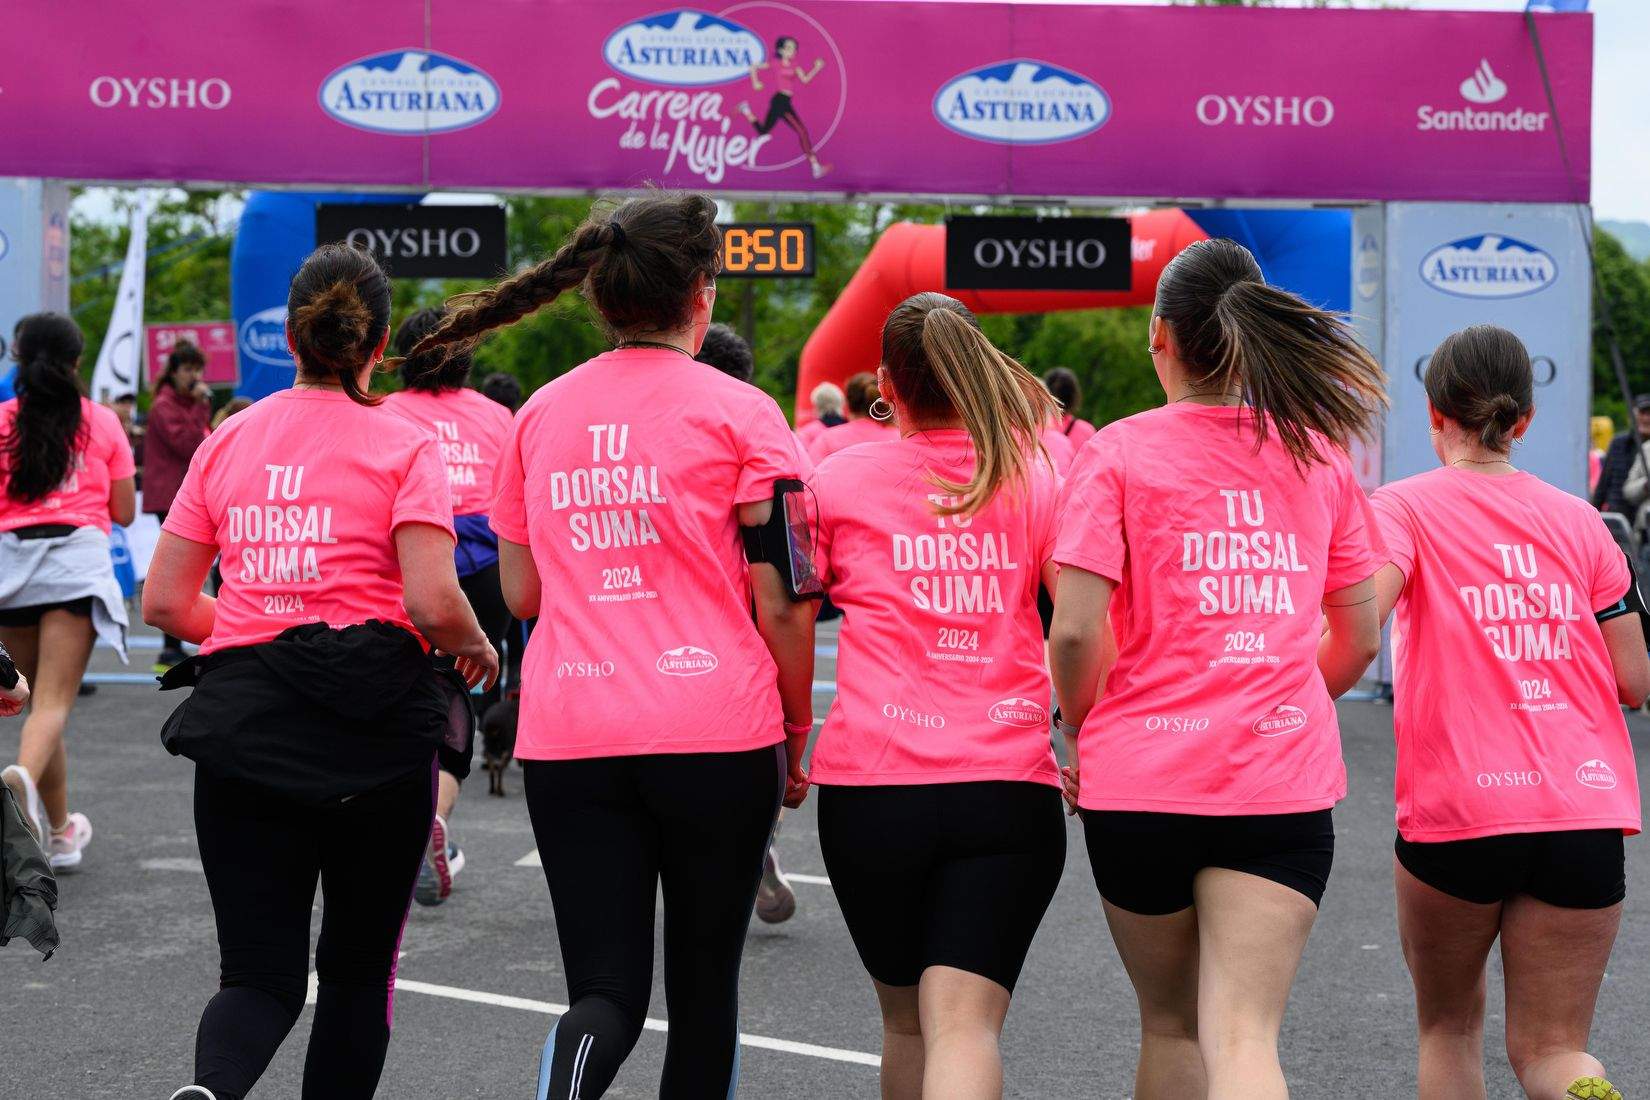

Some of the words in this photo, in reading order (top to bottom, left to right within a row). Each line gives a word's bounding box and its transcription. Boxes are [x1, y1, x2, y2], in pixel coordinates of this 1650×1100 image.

[617, 37, 750, 66] ASTURIANA
[89, 76, 231, 109] OYSHO
[335, 80, 484, 111] ASTURIANA
[588, 78, 724, 119] Carrera
[949, 90, 1095, 121] ASTURIANA
[1196, 94, 1334, 126] OYSHO
[1417, 105, 1549, 131] Santander
[619, 122, 646, 148] de
[650, 120, 670, 150] la
[663, 117, 772, 183] Mujer
[346, 227, 481, 258] OYSHO
[974, 238, 1107, 268] OYSHO
[1431, 258, 1546, 282] ASTURIANA
[432, 420, 459, 441] TU
[586, 424, 629, 462] TU
[439, 442, 485, 464] RSAL
[265, 464, 304, 500] TU
[446, 465, 477, 485] MA
[550, 465, 667, 510] DORSAL
[927, 493, 973, 529] TU
[1219, 489, 1265, 528] TU
[228, 505, 338, 544] DORSAL
[569, 510, 661, 552] SUMA
[240, 546, 322, 584] SUMA
[892, 532, 1018, 571] DORSAL
[1182, 531, 1309, 572] DORSAL
[1494, 543, 1539, 579] TU
[602, 565, 642, 590] 2024
[264, 594, 304, 614] 2024
[910, 575, 1005, 614] SUMA
[1199, 575, 1296, 616] SUMA
[1459, 583, 1581, 622] DORSAL
[936, 627, 979, 650] 2024
[1224, 631, 1266, 652] 2024
[1483, 623, 1573, 662] SUMA
[557, 660, 615, 679] OYSHO
[662, 658, 713, 670] ASTURIANA
[883, 703, 946, 729] OYSHO
[994, 707, 1042, 722] ASTURIANA
[1145, 716, 1210, 734] OYSHO
[1476, 770, 1542, 788] OYSHO
